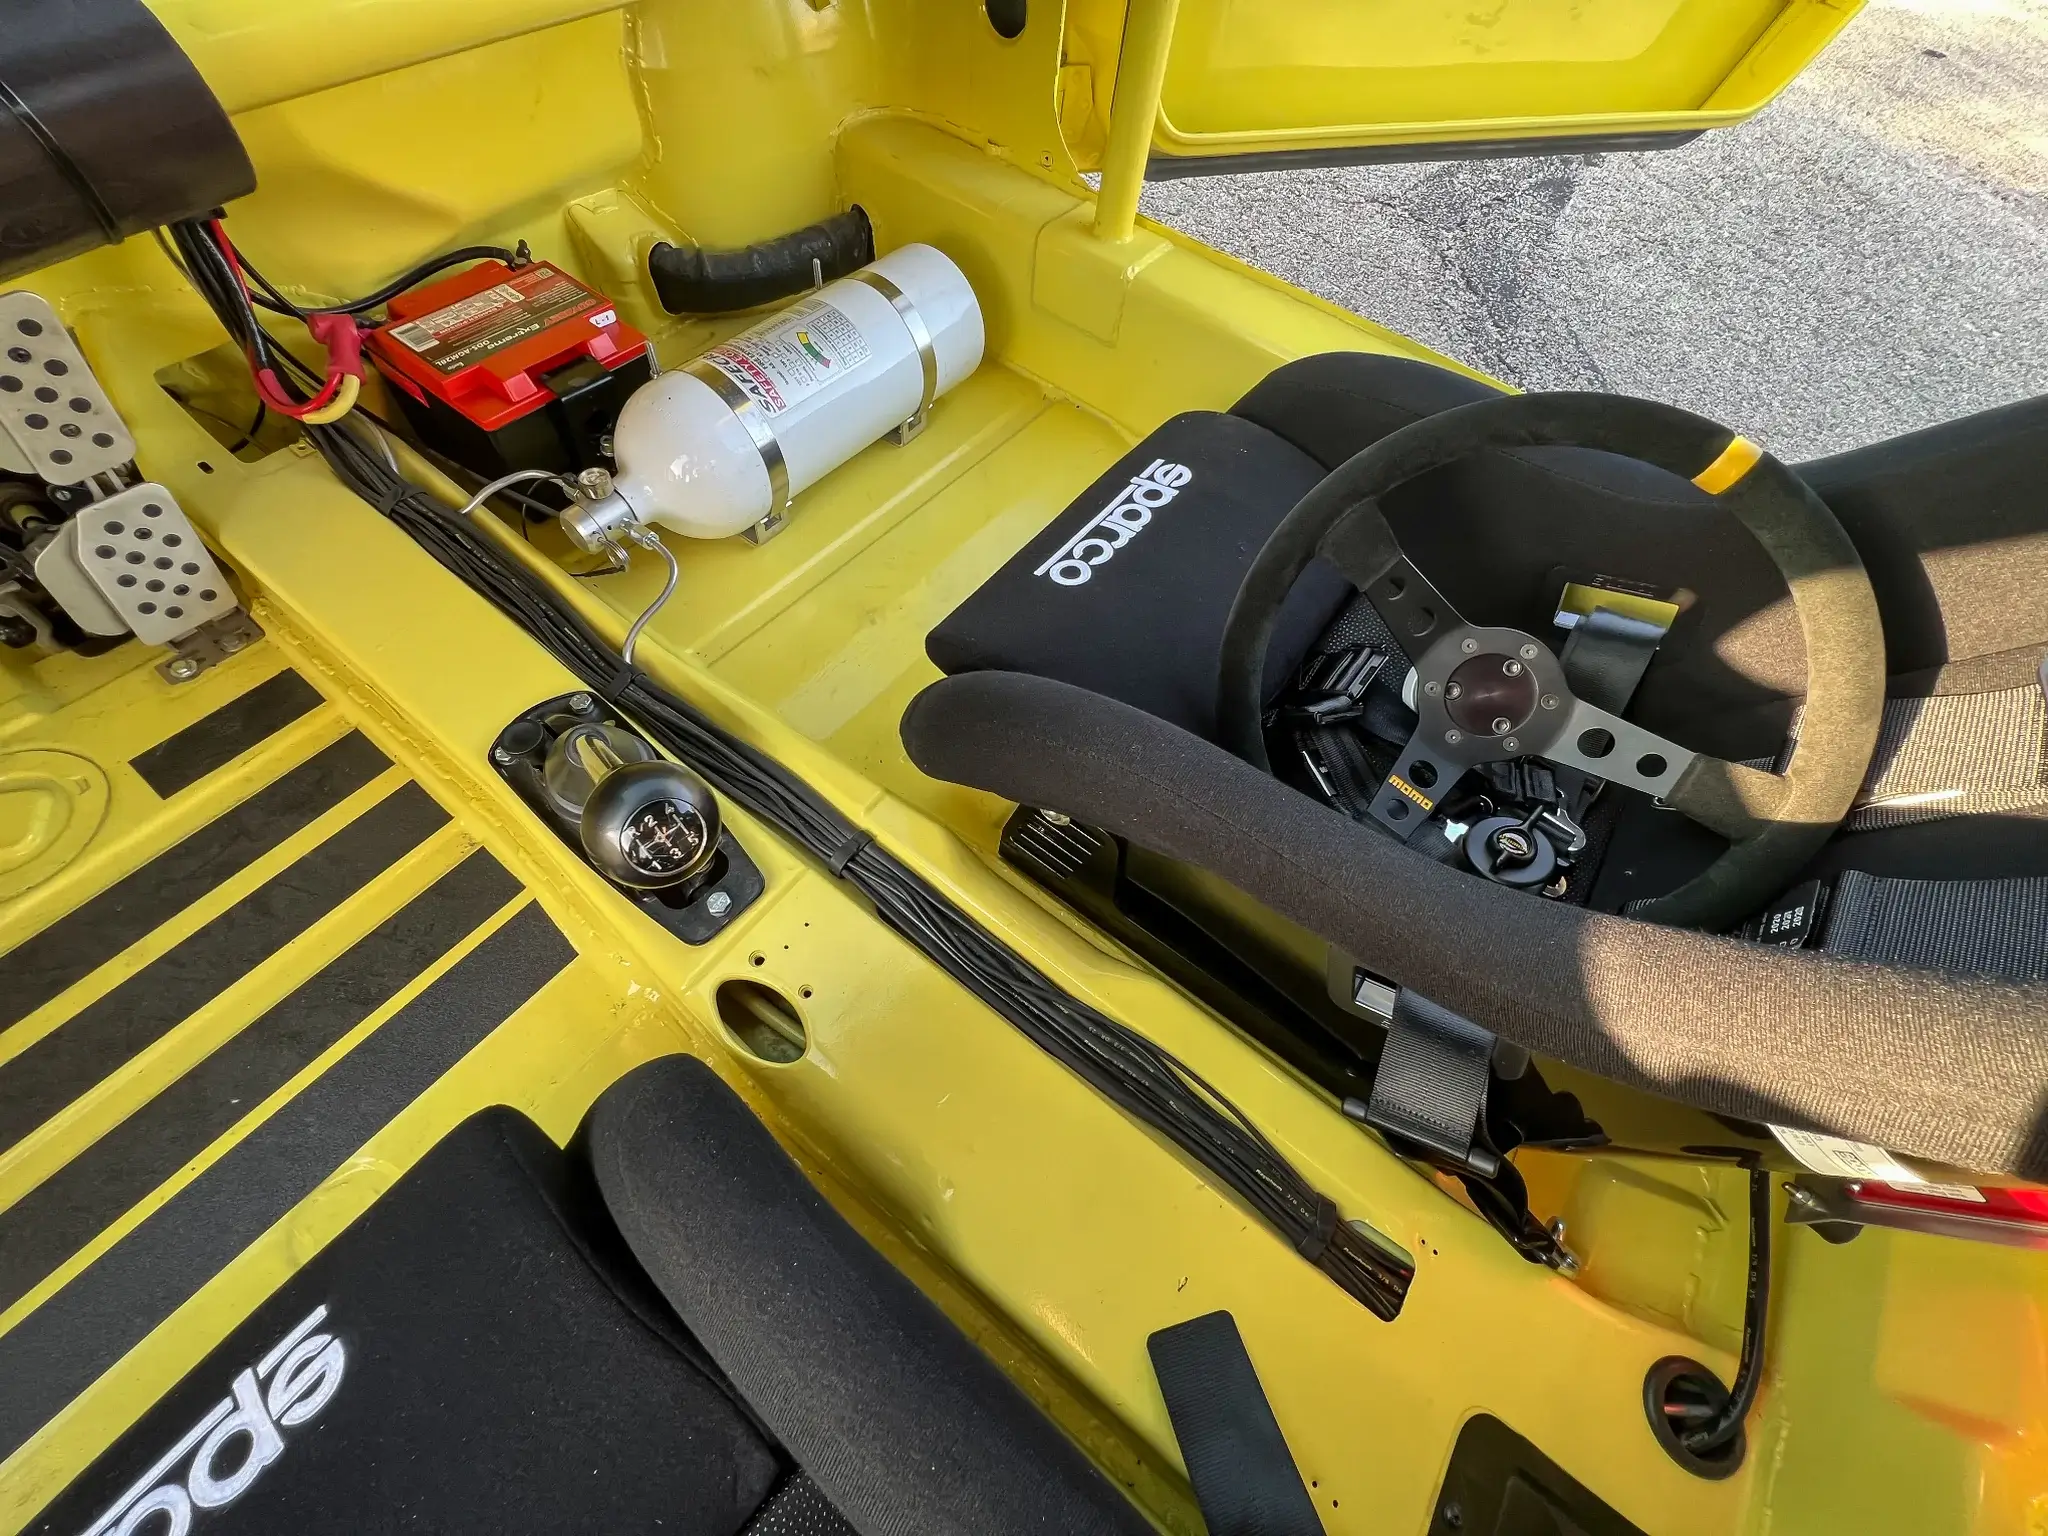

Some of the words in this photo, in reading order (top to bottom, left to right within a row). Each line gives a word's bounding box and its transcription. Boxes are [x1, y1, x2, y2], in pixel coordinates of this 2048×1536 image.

[487, 322, 540, 350] Extreme
[1038, 460, 1192, 586] sparco
[644, 814, 658, 828] 2
[670, 847, 682, 859] 3
[687, 831, 699, 846] 5
[1770, 914, 1782, 934] 2020
